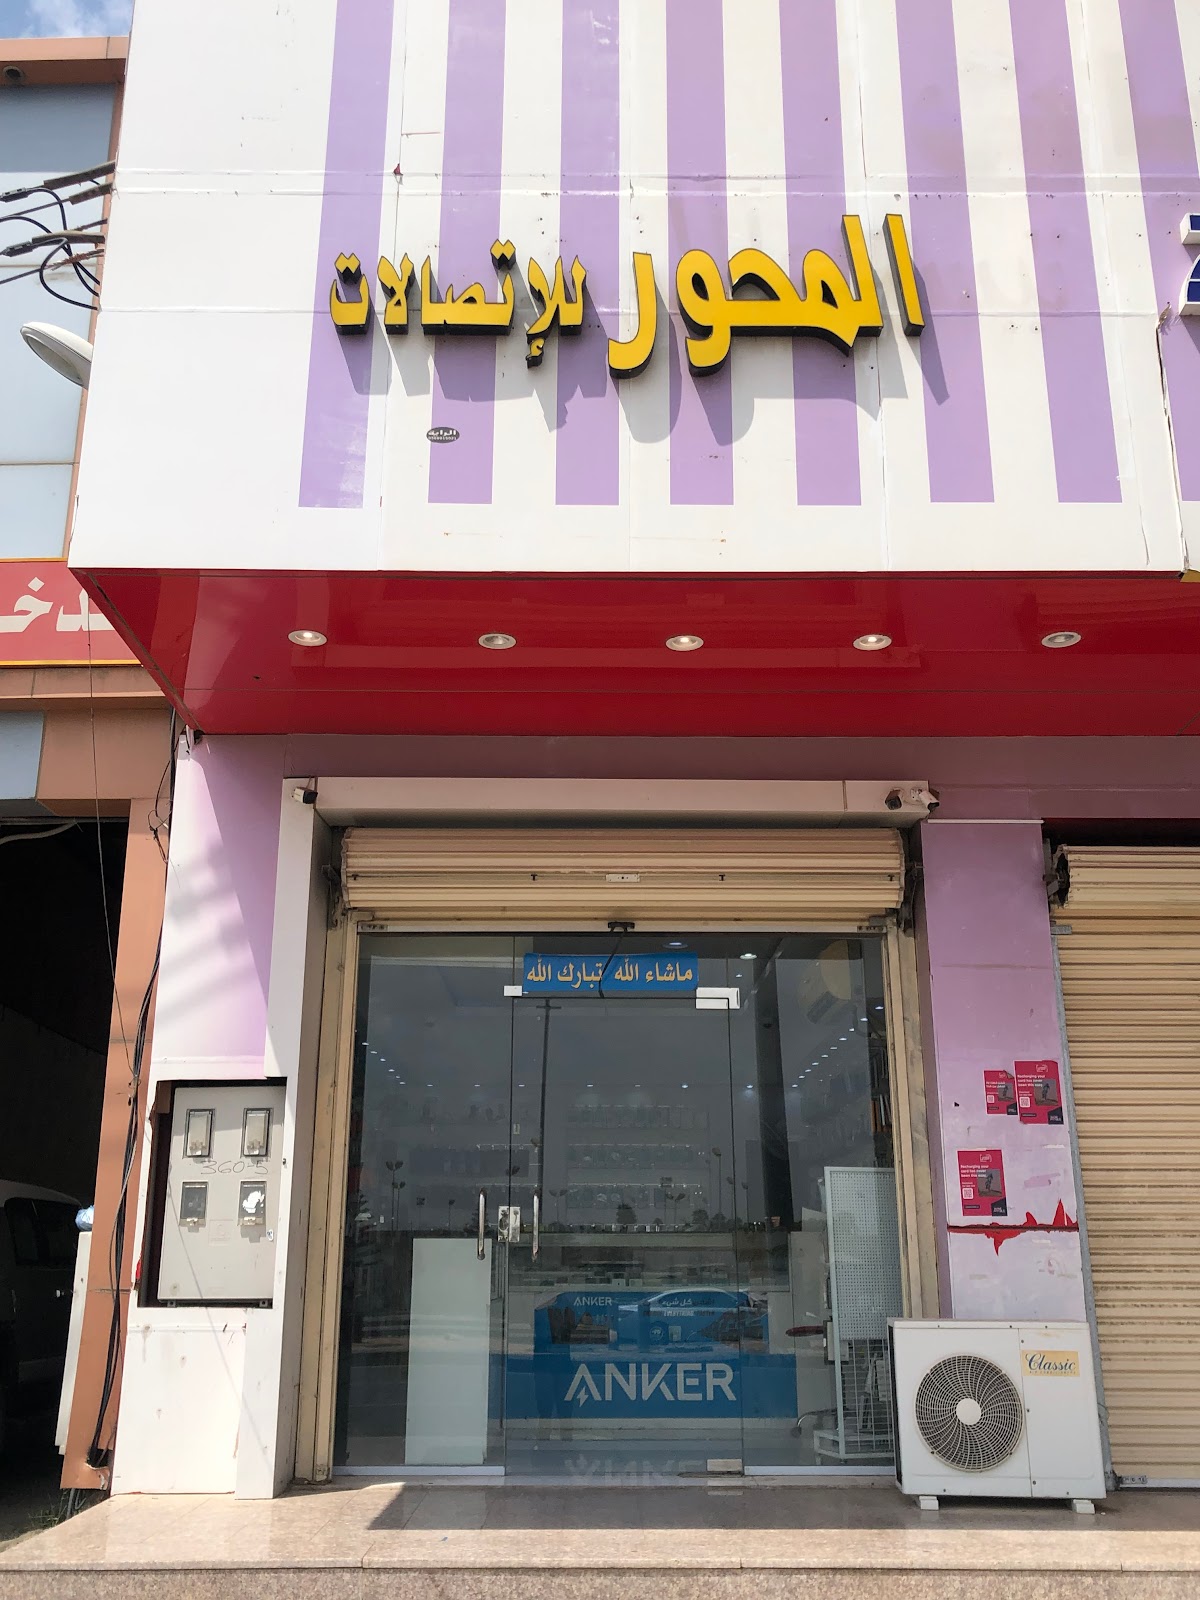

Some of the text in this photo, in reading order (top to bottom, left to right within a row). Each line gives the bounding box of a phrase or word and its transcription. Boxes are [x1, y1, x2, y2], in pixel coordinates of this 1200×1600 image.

[608, 213, 926, 379] المحور
[526, 956, 693, 989] ماشاء الله تبارك الله
[573, 1296, 613, 1307] ANKER
[1025, 1353, 1076, 1371] Classic
[563, 1362, 738, 1407] ANKER
